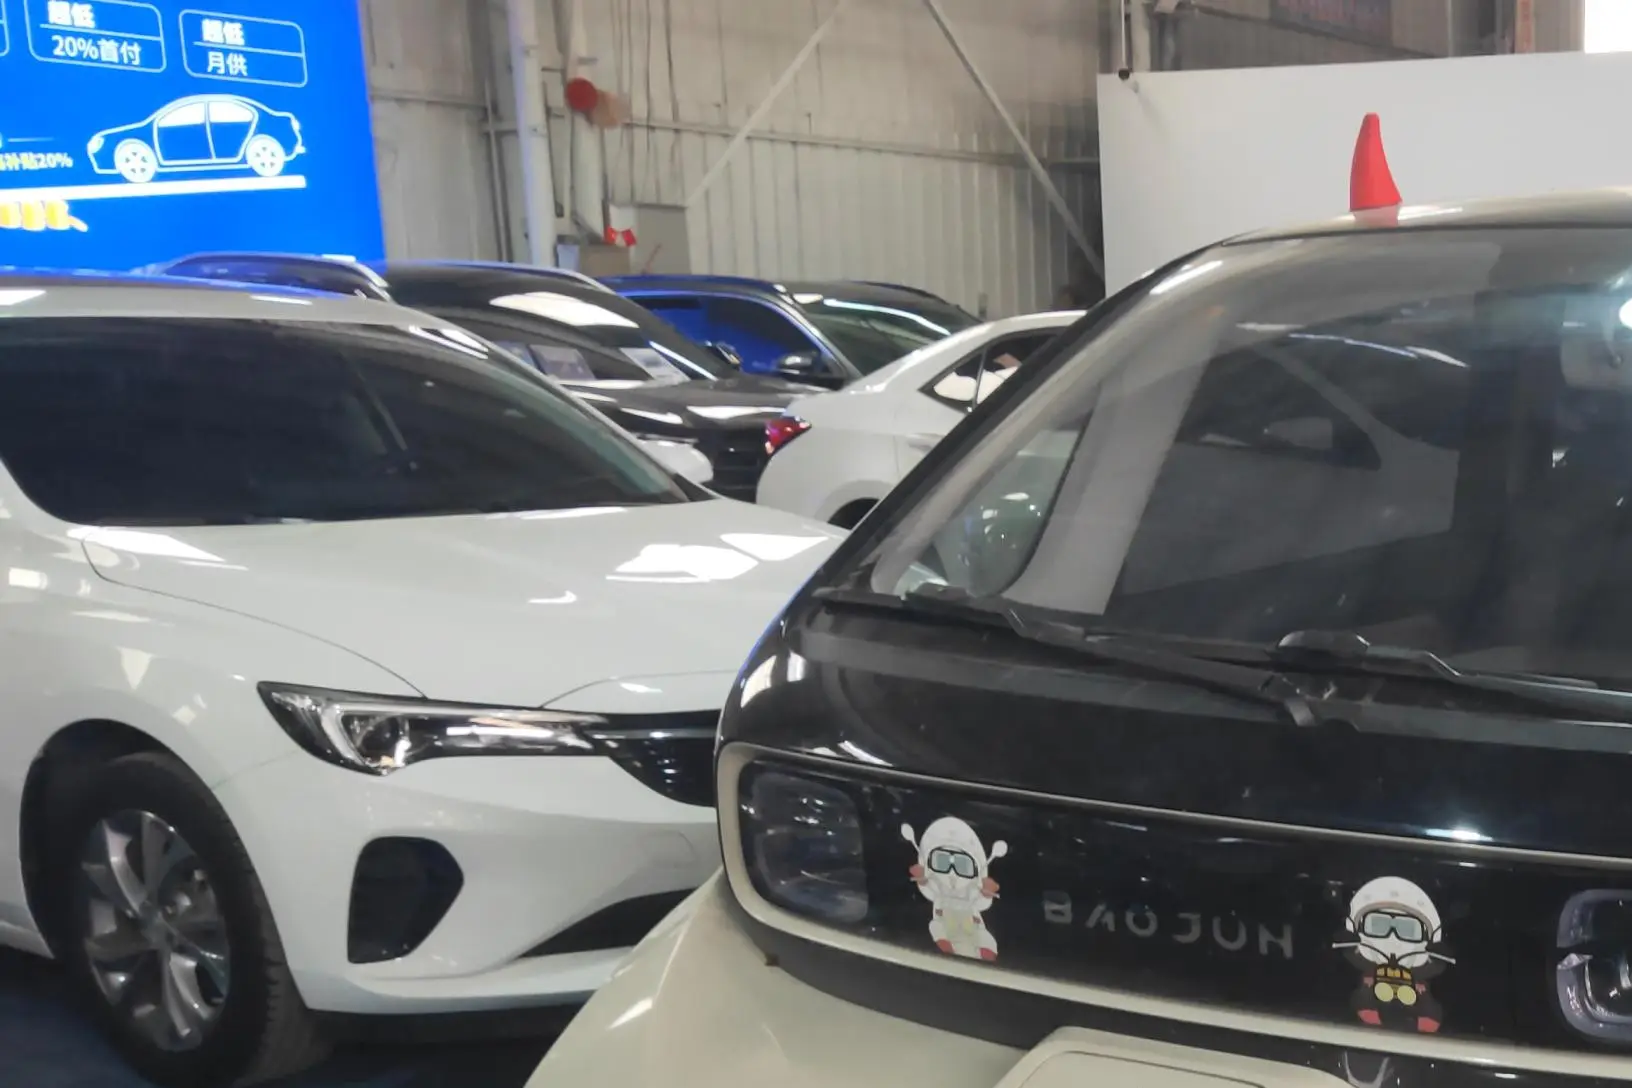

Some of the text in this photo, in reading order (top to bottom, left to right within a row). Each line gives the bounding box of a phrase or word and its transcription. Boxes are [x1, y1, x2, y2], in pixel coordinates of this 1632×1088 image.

[51, 34, 142, 66] 20%首付
[207, 51, 248, 76] 月供
[1042, 890, 1293, 959] BAOJUN
